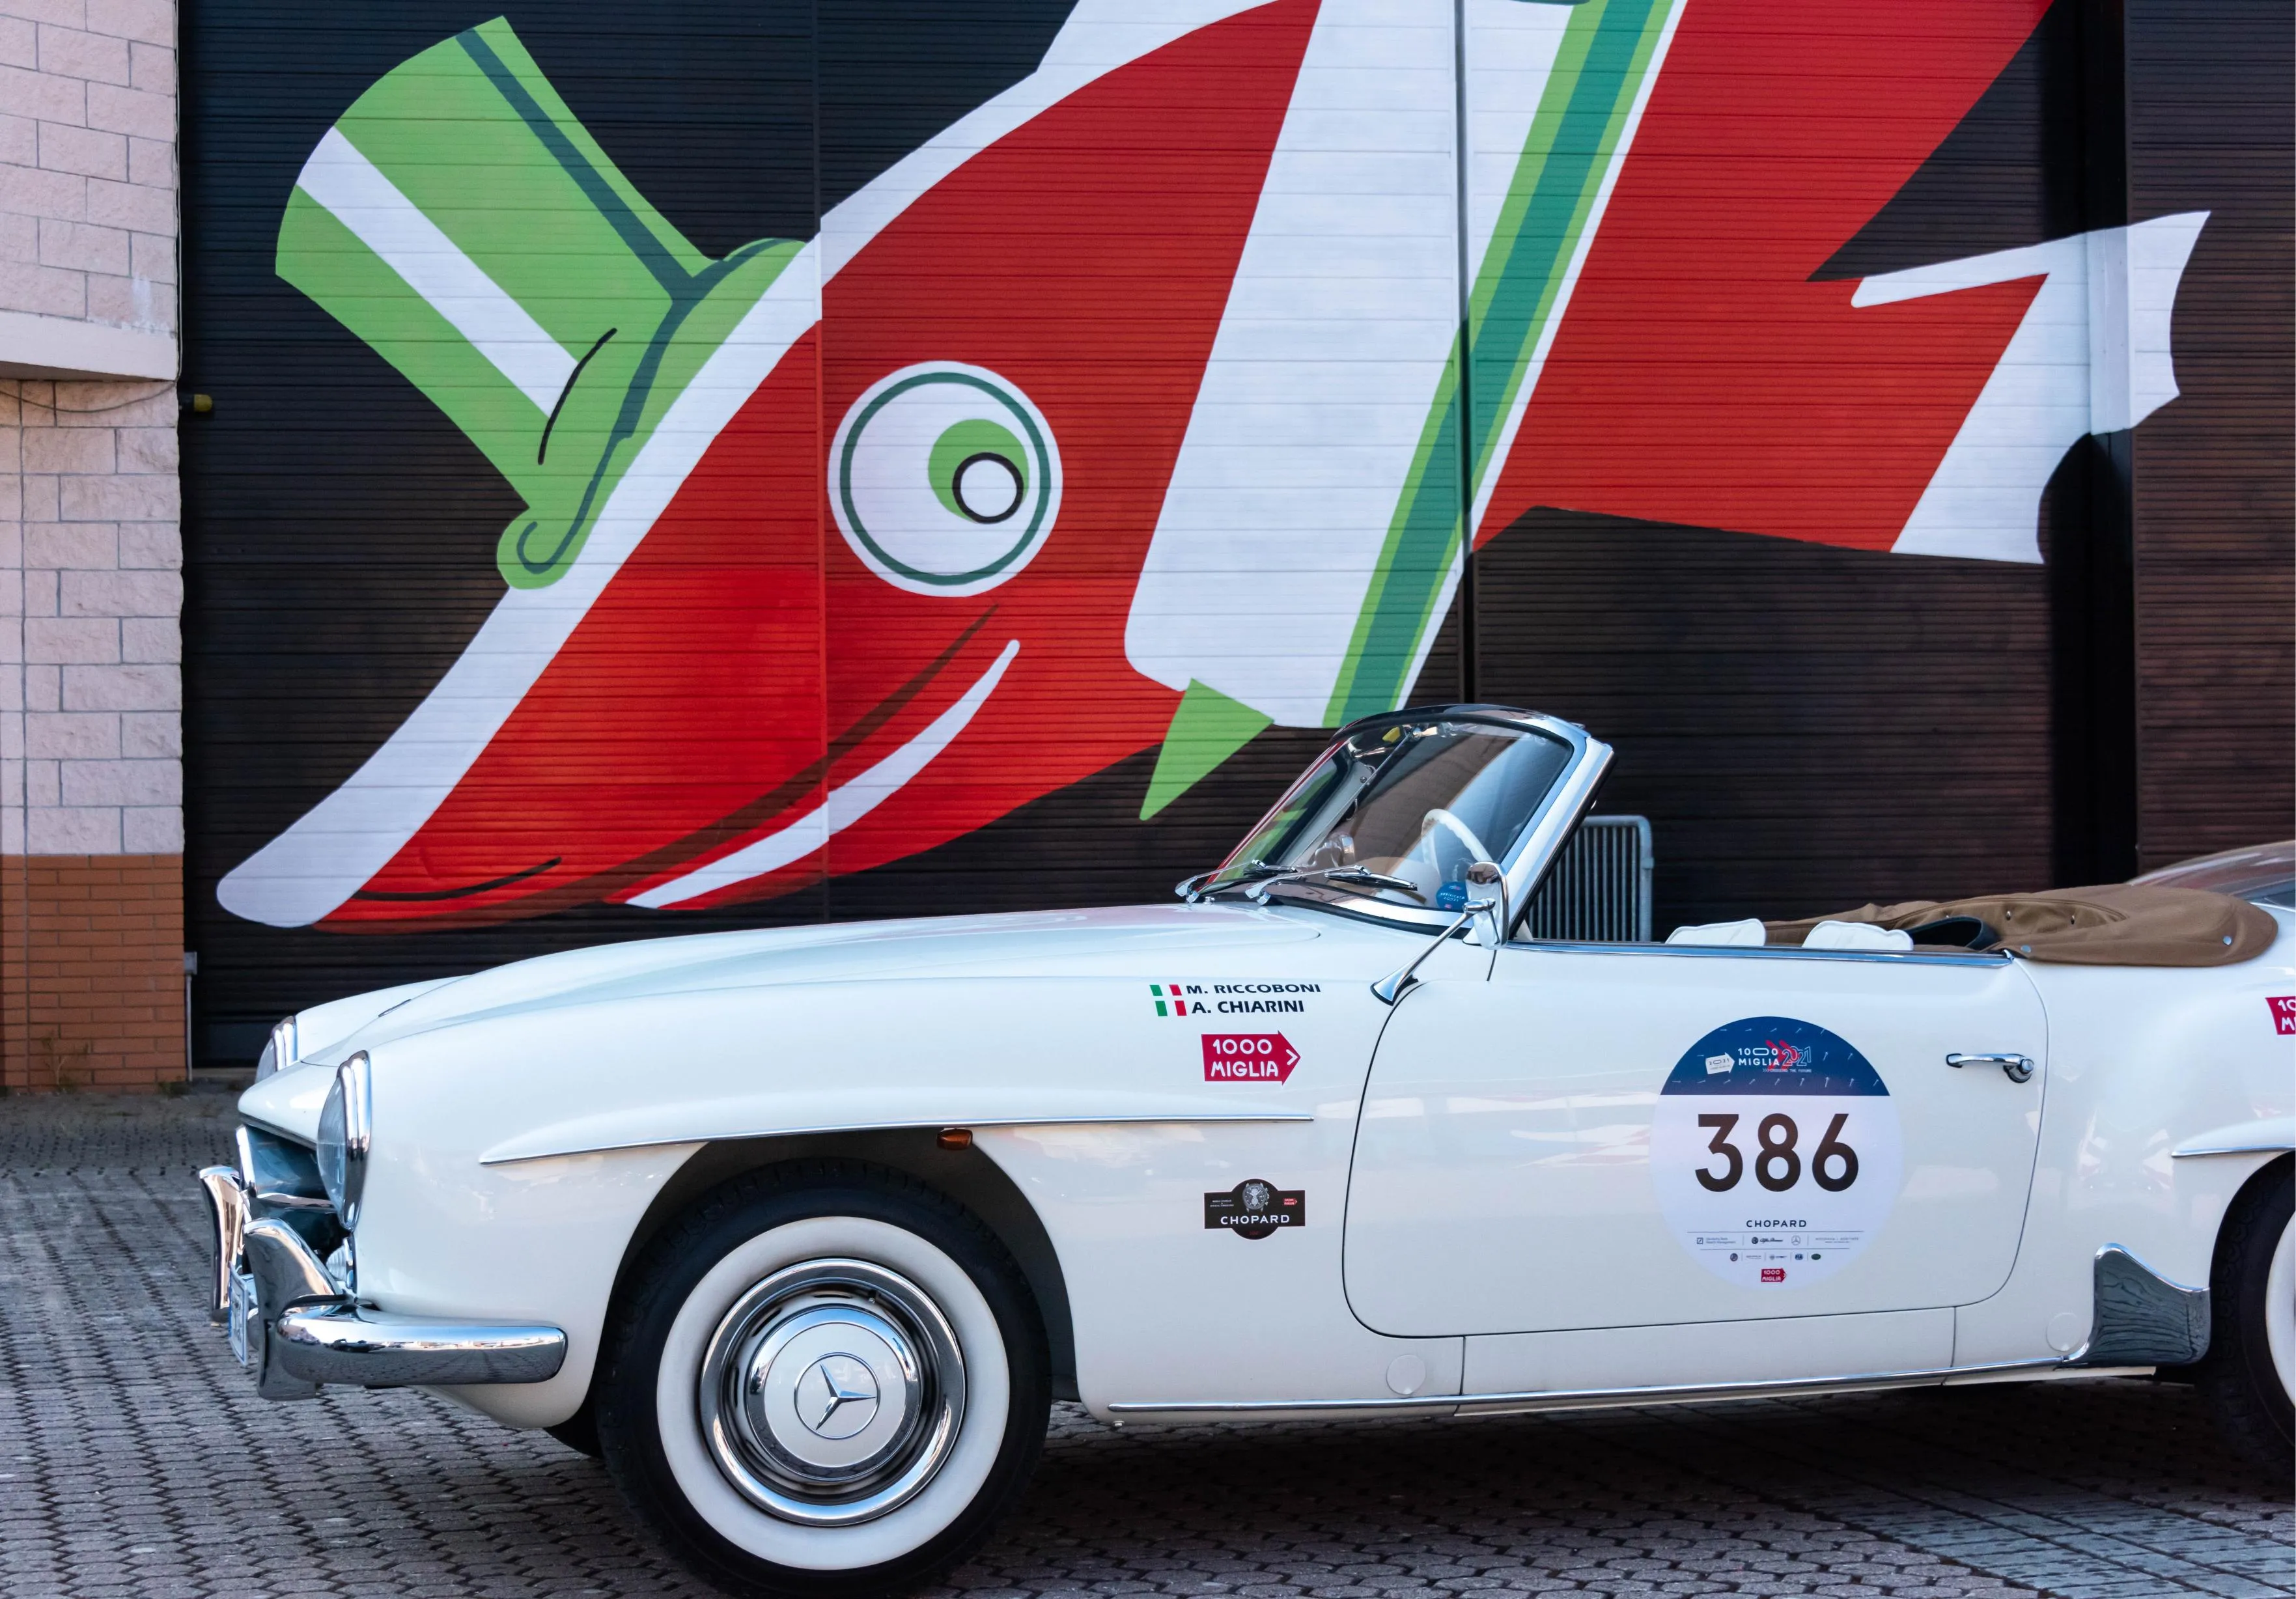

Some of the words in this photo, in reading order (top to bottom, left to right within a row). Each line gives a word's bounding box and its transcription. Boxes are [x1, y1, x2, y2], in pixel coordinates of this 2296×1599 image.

[1186, 985, 1208, 994] M.
[1214, 984, 1321, 994] RICCOBONI
[1192, 1001, 1211, 1014] A.
[1217, 1001, 1304, 1013] CHIARINI
[1212, 1038, 1272, 1055] 1000
[1782, 1046, 1812, 1066] 2021
[1211, 1061, 1278, 1078] MIGLIA
[1695, 1113, 1859, 1192] 386
[1220, 1214, 1290, 1225] CHOPARD
